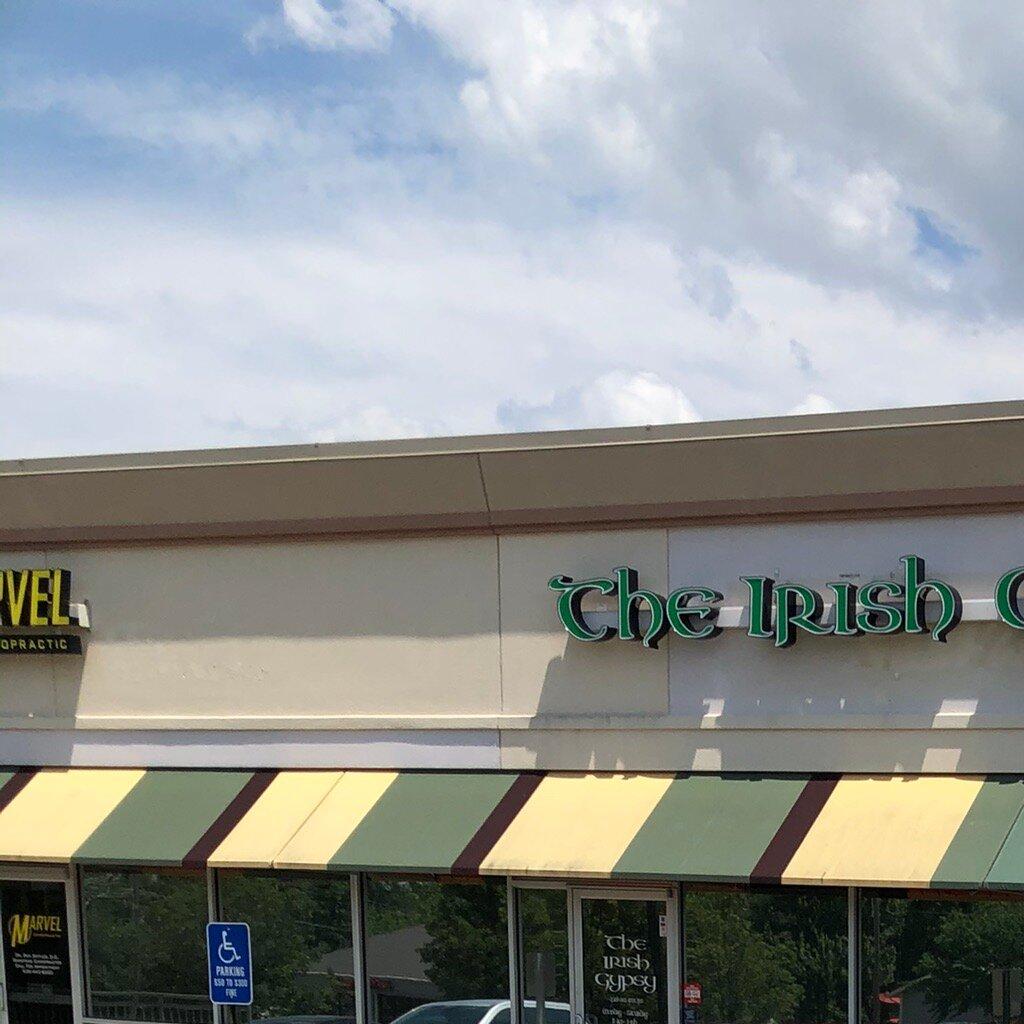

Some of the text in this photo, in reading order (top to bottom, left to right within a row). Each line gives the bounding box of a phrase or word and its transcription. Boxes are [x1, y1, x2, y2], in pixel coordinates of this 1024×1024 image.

[0, 568, 70, 626] VEL
[547, 565, 718, 649] The
[216, 966, 245, 977] PARKING
